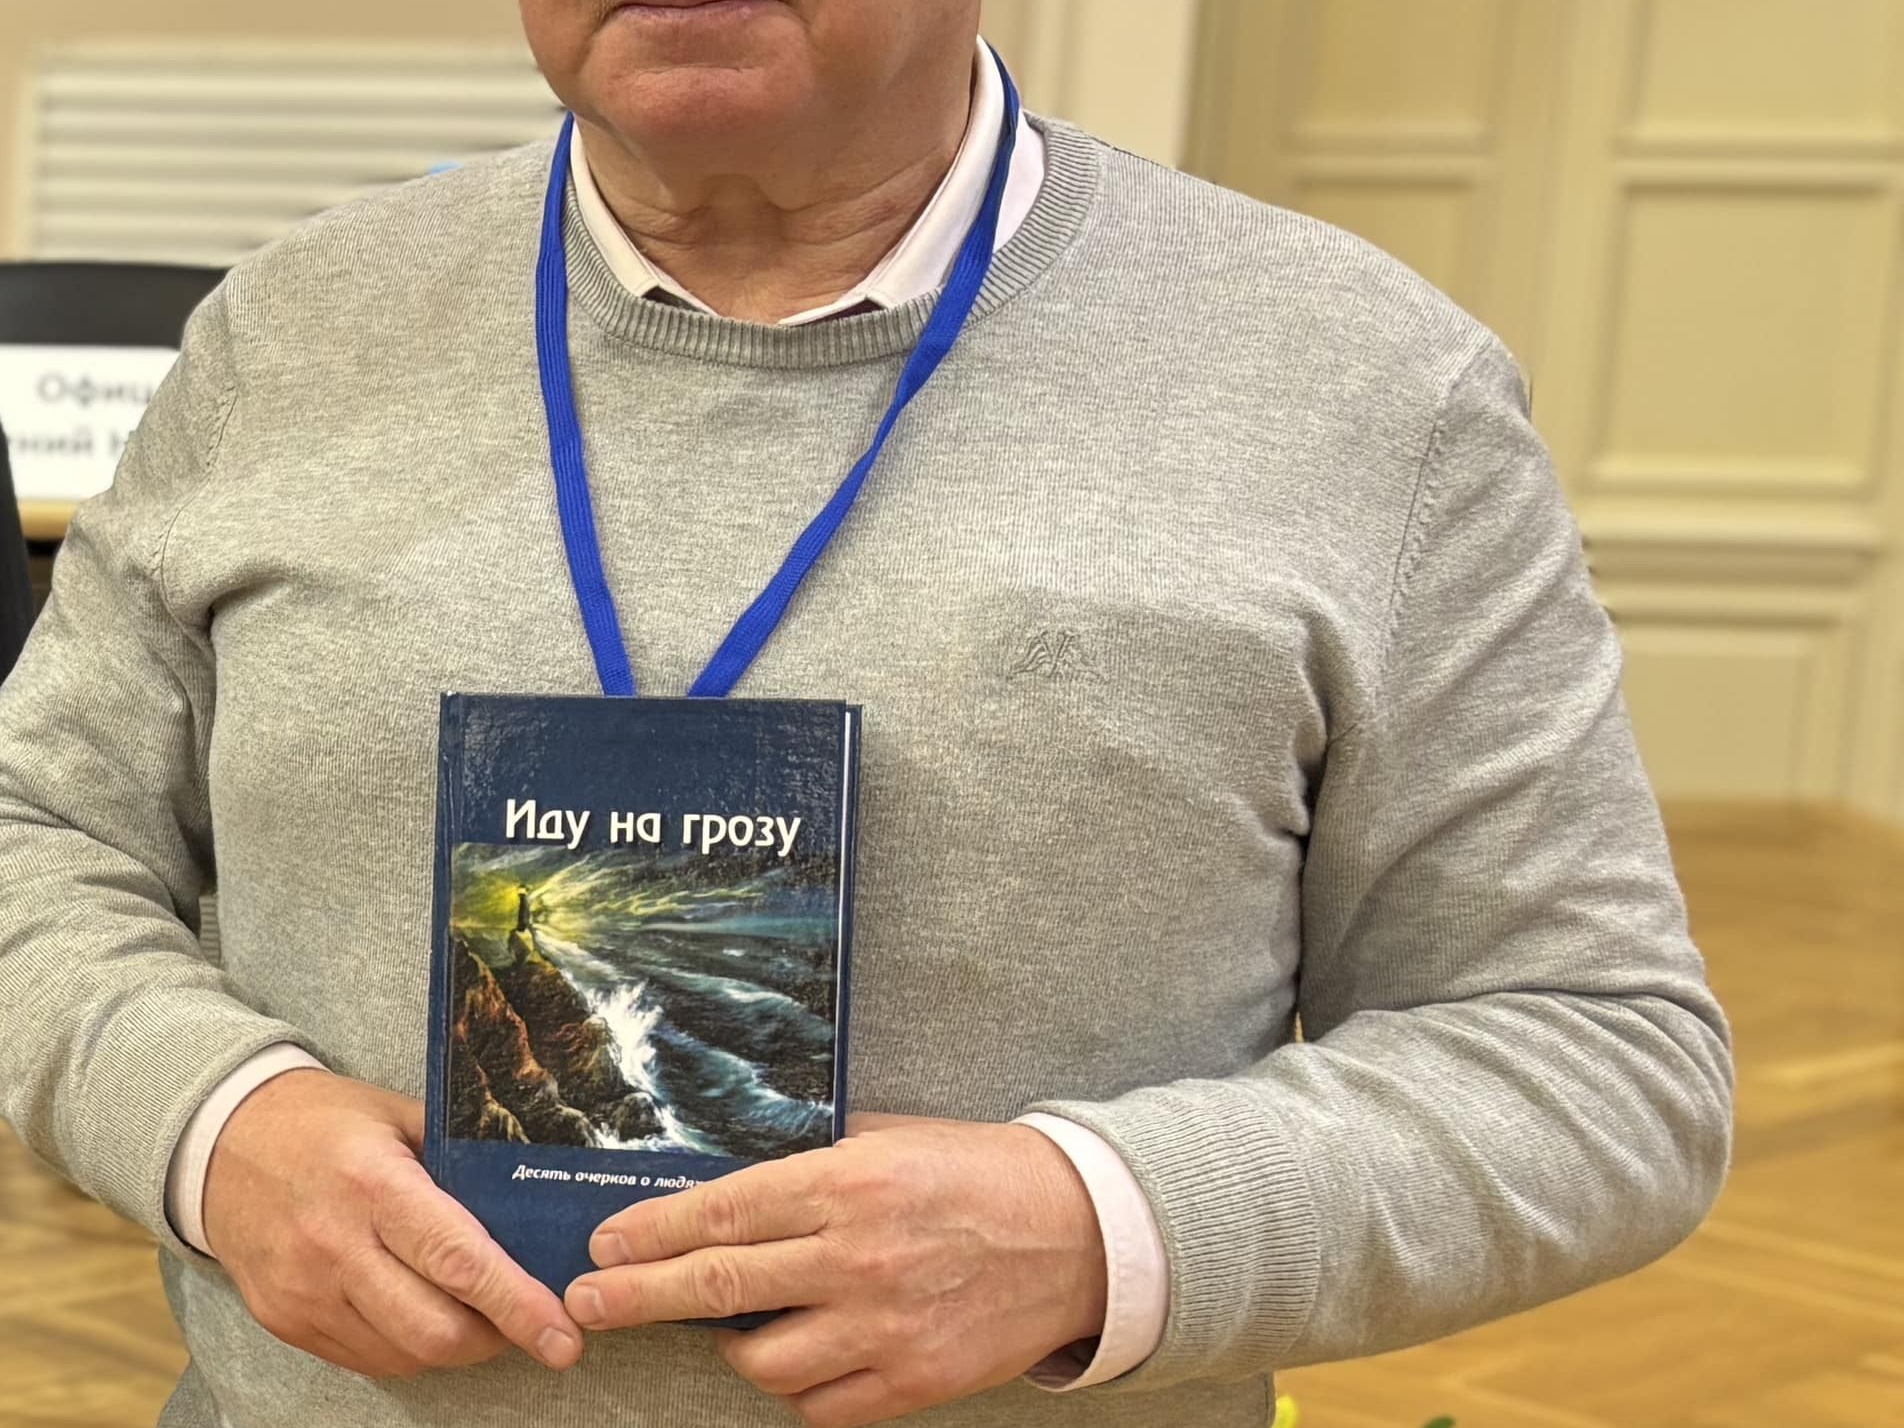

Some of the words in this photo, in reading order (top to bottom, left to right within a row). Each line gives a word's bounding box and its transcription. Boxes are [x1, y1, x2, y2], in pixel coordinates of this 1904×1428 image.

[505, 798, 591, 850] Иду
[610, 811, 662, 843] на
[682, 813, 801, 857] грозу
[511, 1164, 571, 1181] Десять
[575, 1172, 637, 1186] очерков
[640, 1176, 651, 1187] о
